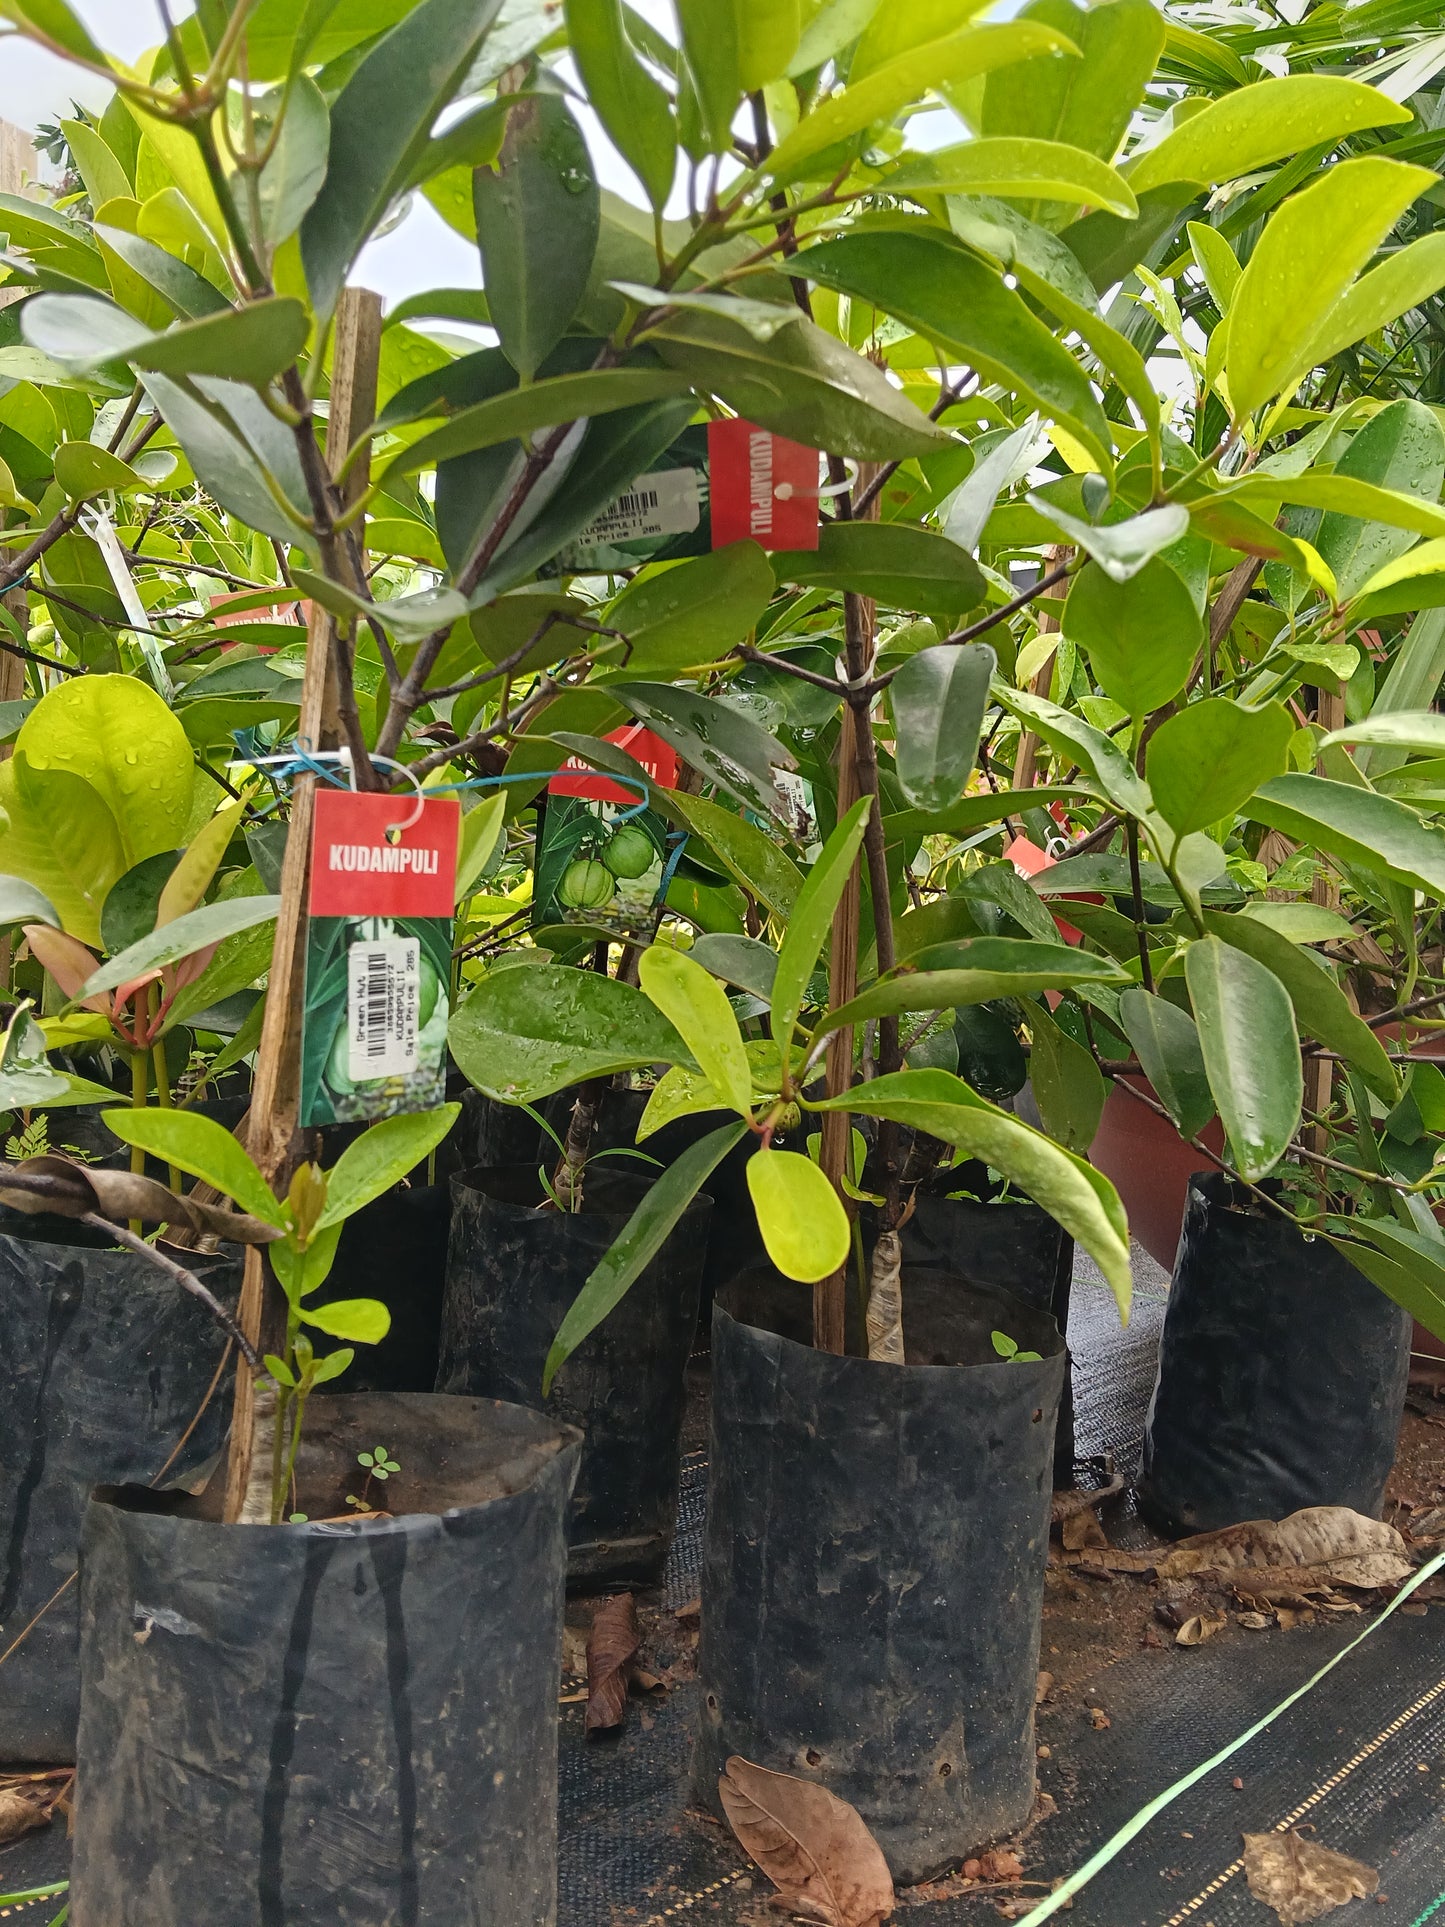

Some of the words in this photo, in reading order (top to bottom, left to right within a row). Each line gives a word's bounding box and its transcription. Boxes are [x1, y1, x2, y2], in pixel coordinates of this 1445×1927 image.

[749, 431, 773, 535] KUDAMPULI
[597, 530, 629, 543] Price
[329, 844, 438, 874] KUDAMPULI
[406, 949, 415, 971] 285
[356, 975, 366, 998] Hut
[405, 985, 415, 1022] Price
[356, 1004, 366, 1043] Green
[405, 1027, 414, 1057] Sale
